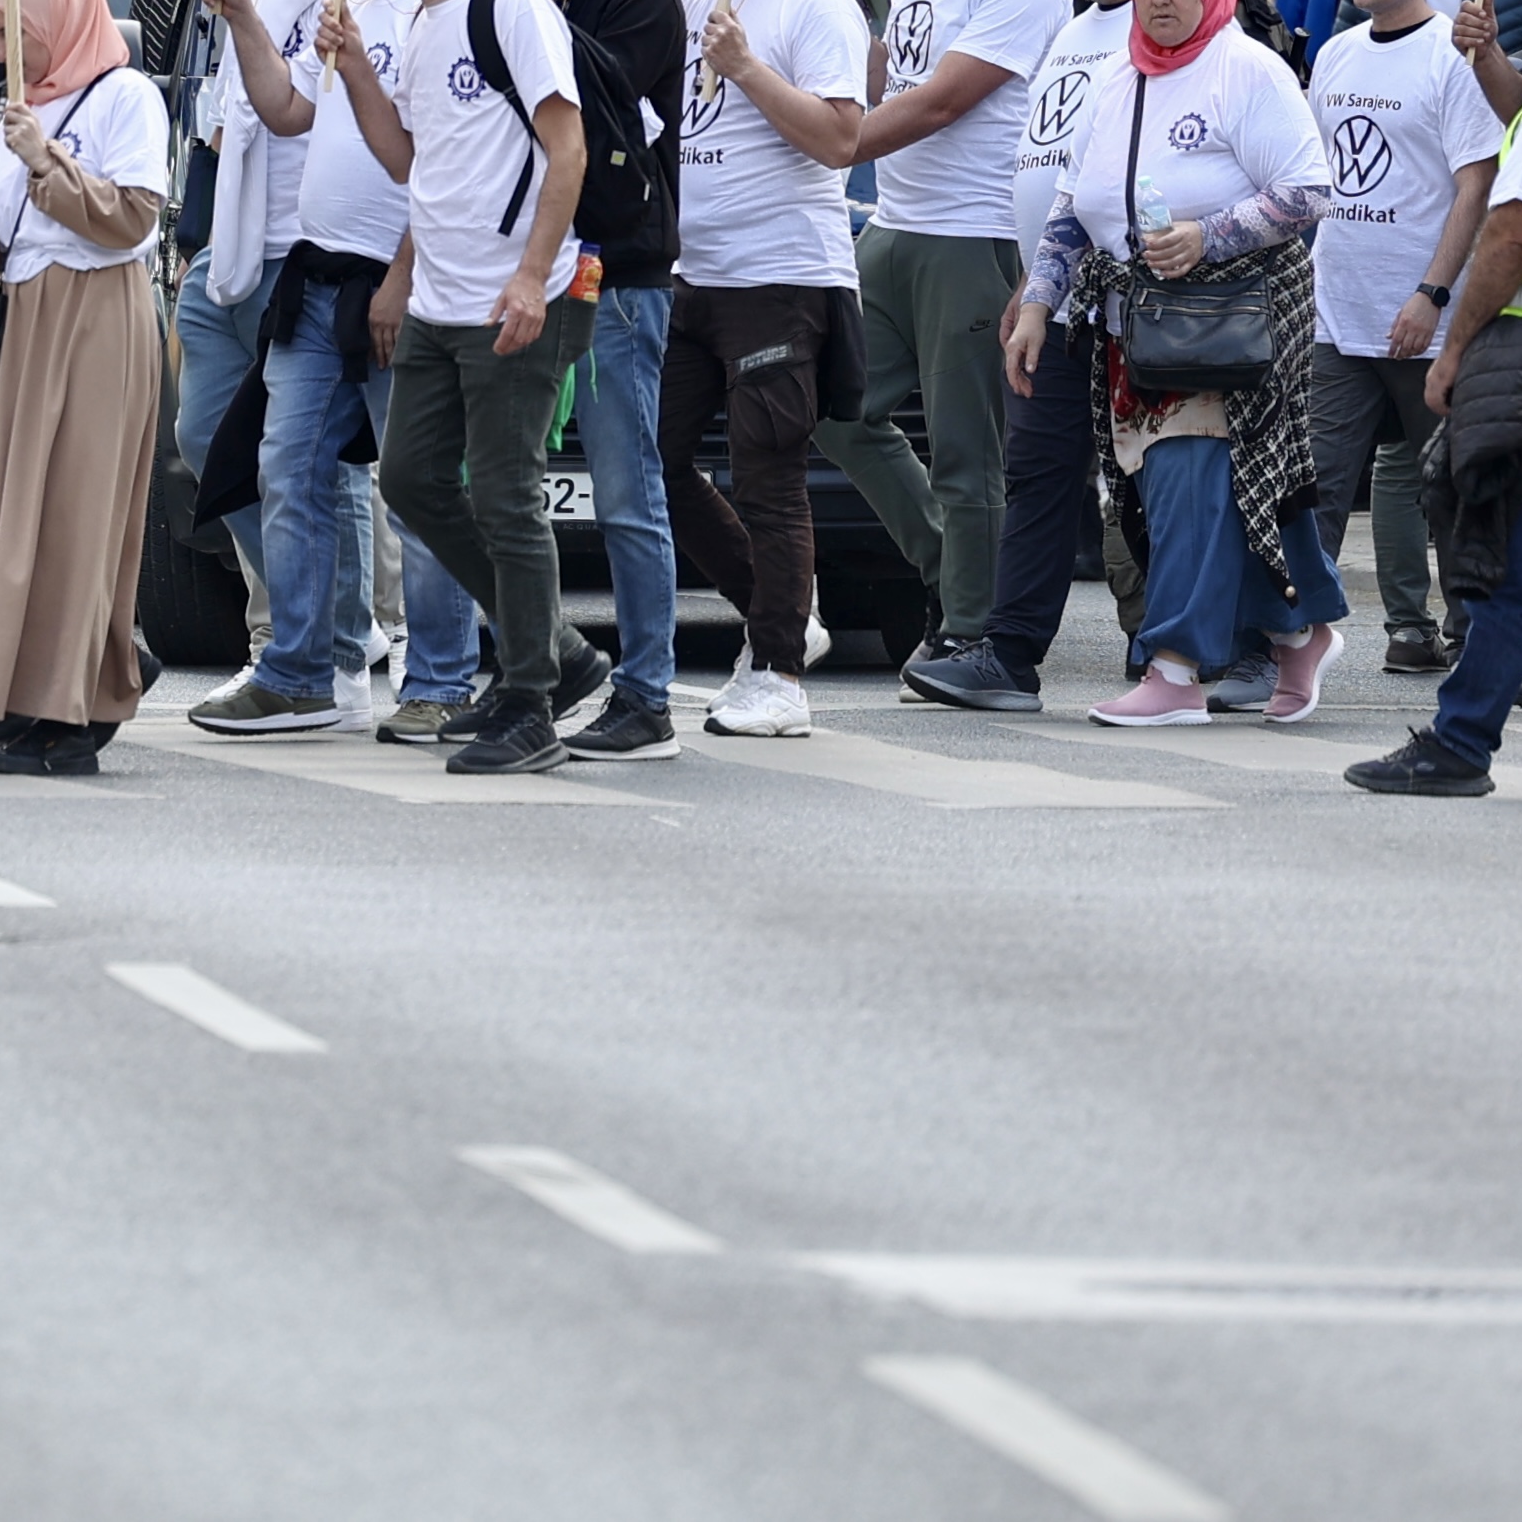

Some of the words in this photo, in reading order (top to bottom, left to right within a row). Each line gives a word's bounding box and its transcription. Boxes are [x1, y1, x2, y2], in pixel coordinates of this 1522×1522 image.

[1050, 54, 1070, 67] VW
[1068, 50, 1116, 66] Sarajev
[1327, 93, 1345, 107] VW
[1347, 93, 1402, 111] Sarajevo
[679, 147, 723, 165] dikat
[739, 345, 788, 371] FUTURE
